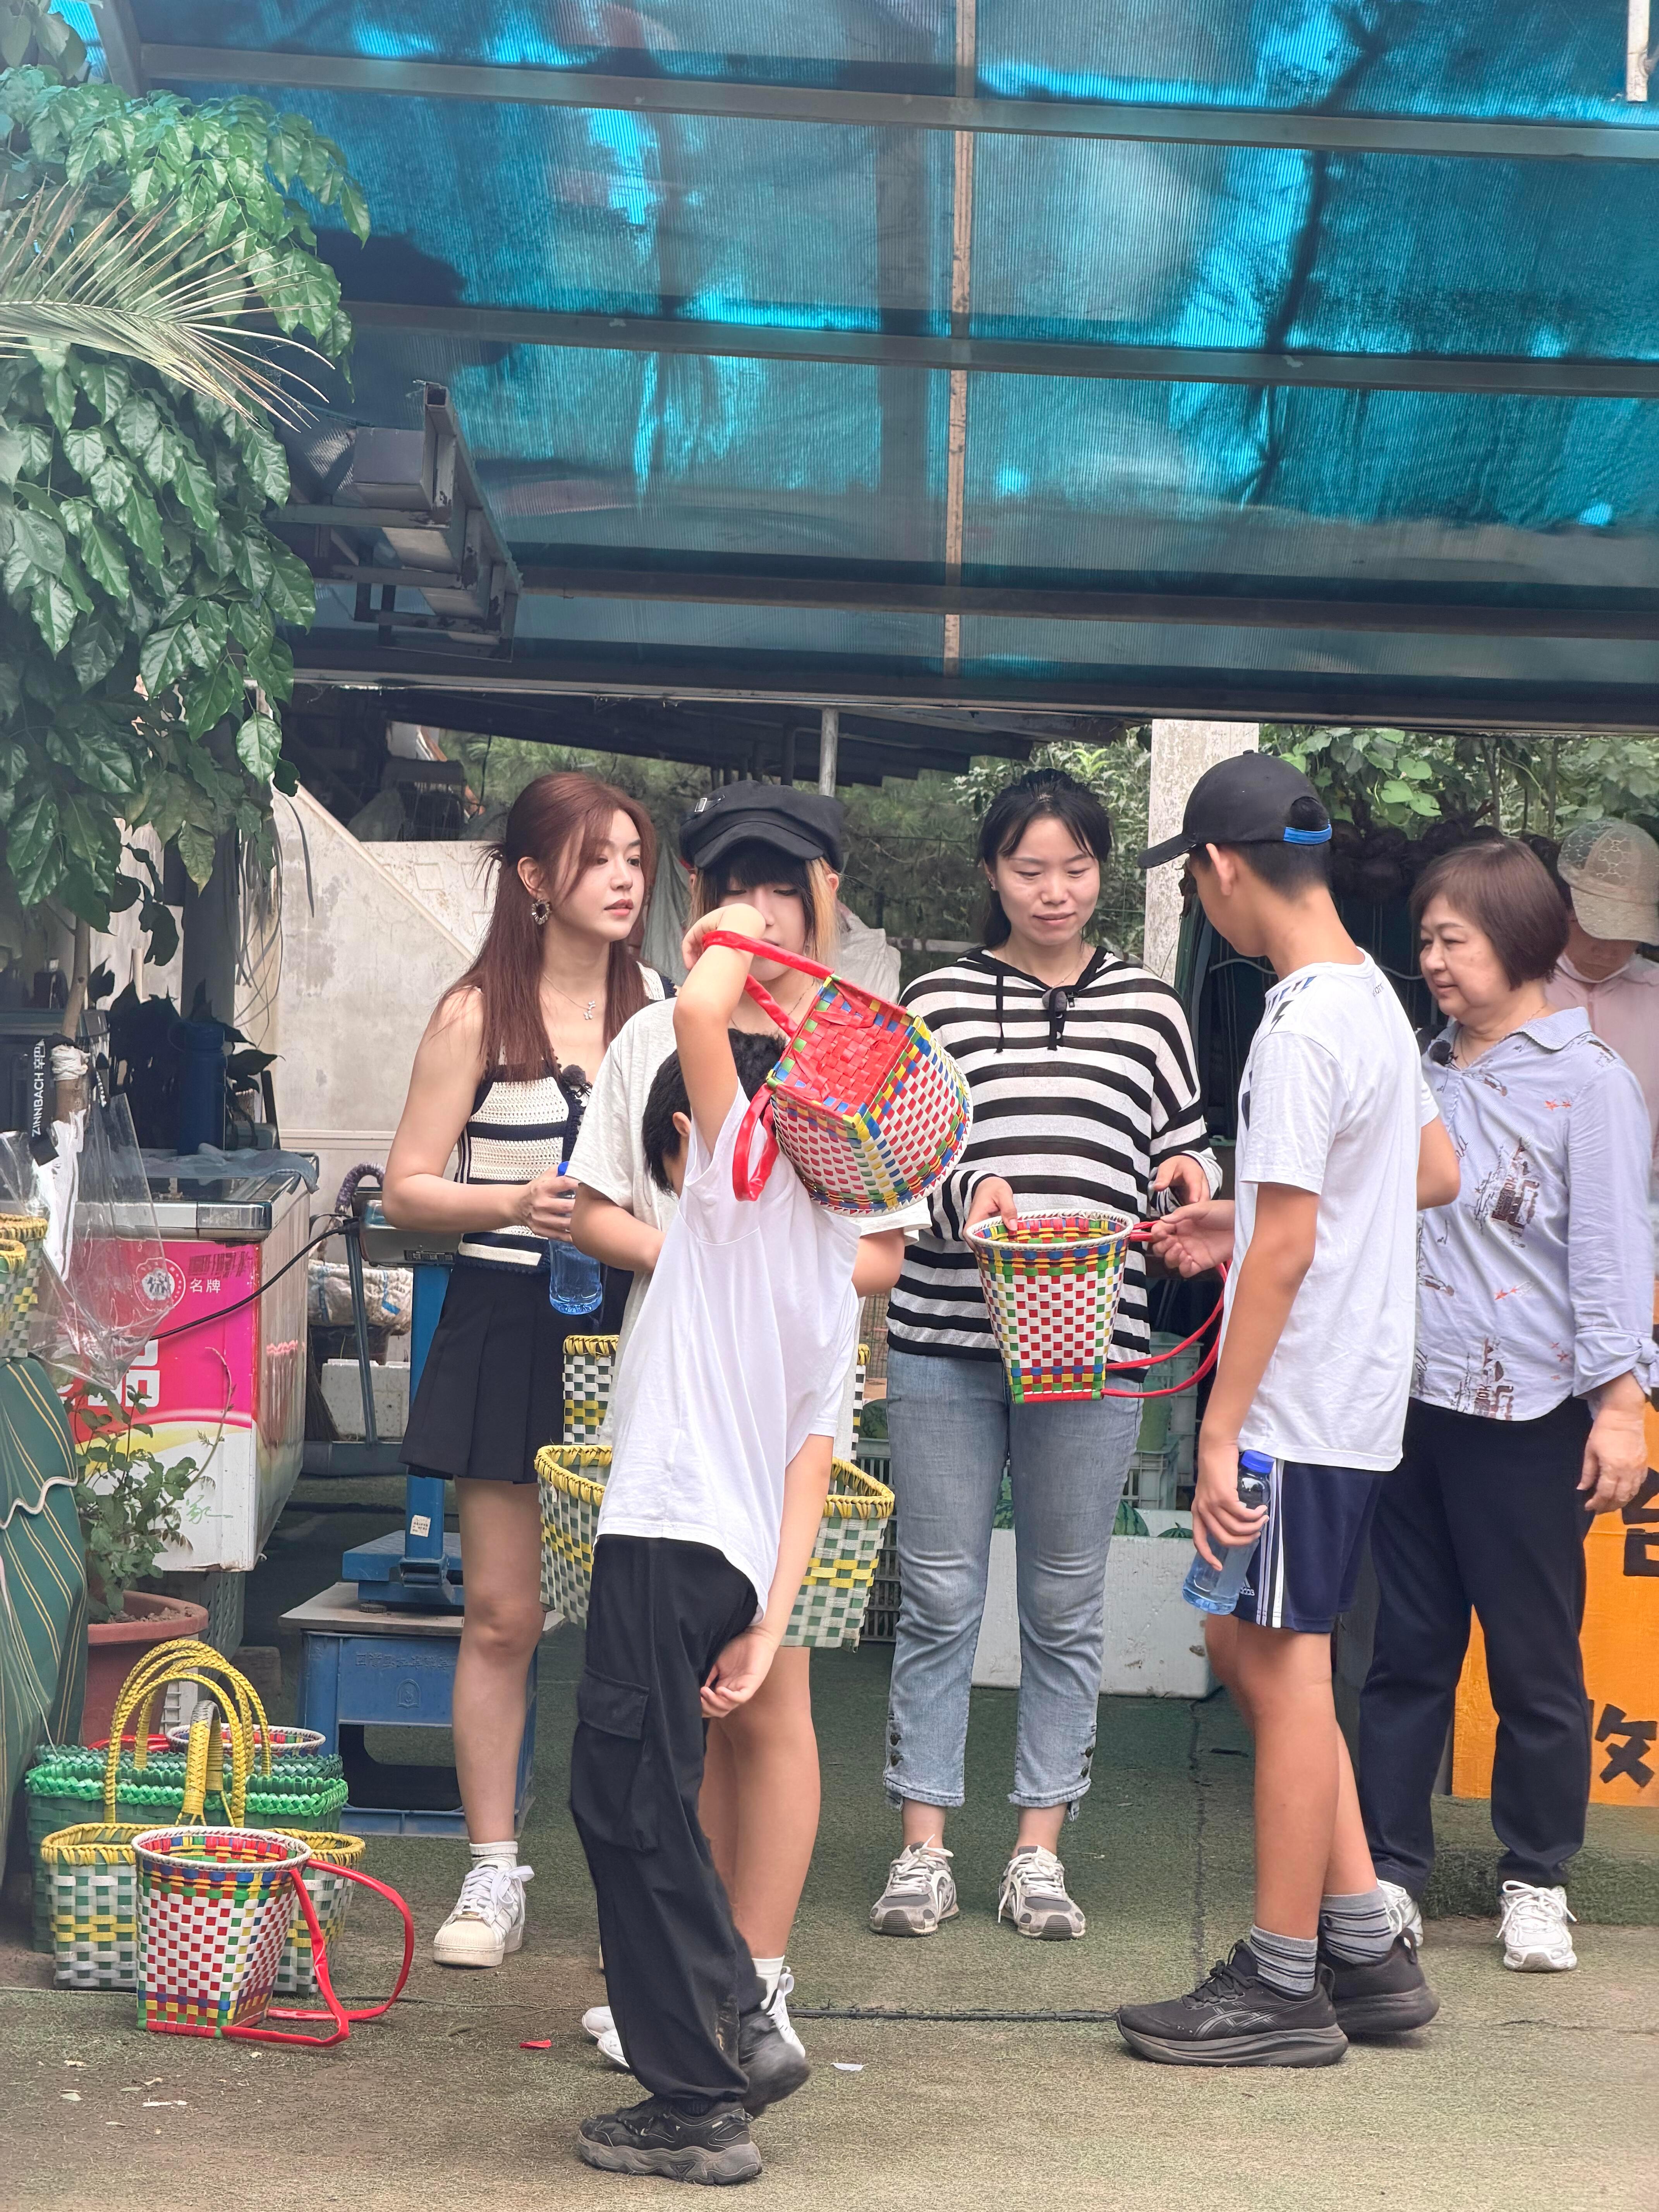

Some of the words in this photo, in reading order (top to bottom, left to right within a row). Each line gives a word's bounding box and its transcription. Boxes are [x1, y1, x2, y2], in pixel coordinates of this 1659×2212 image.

[33, 1038, 46, 1069] 辛巴
[32, 1072, 44, 1137] ZINNBACH
[190, 1278, 221, 1293] 名牌
